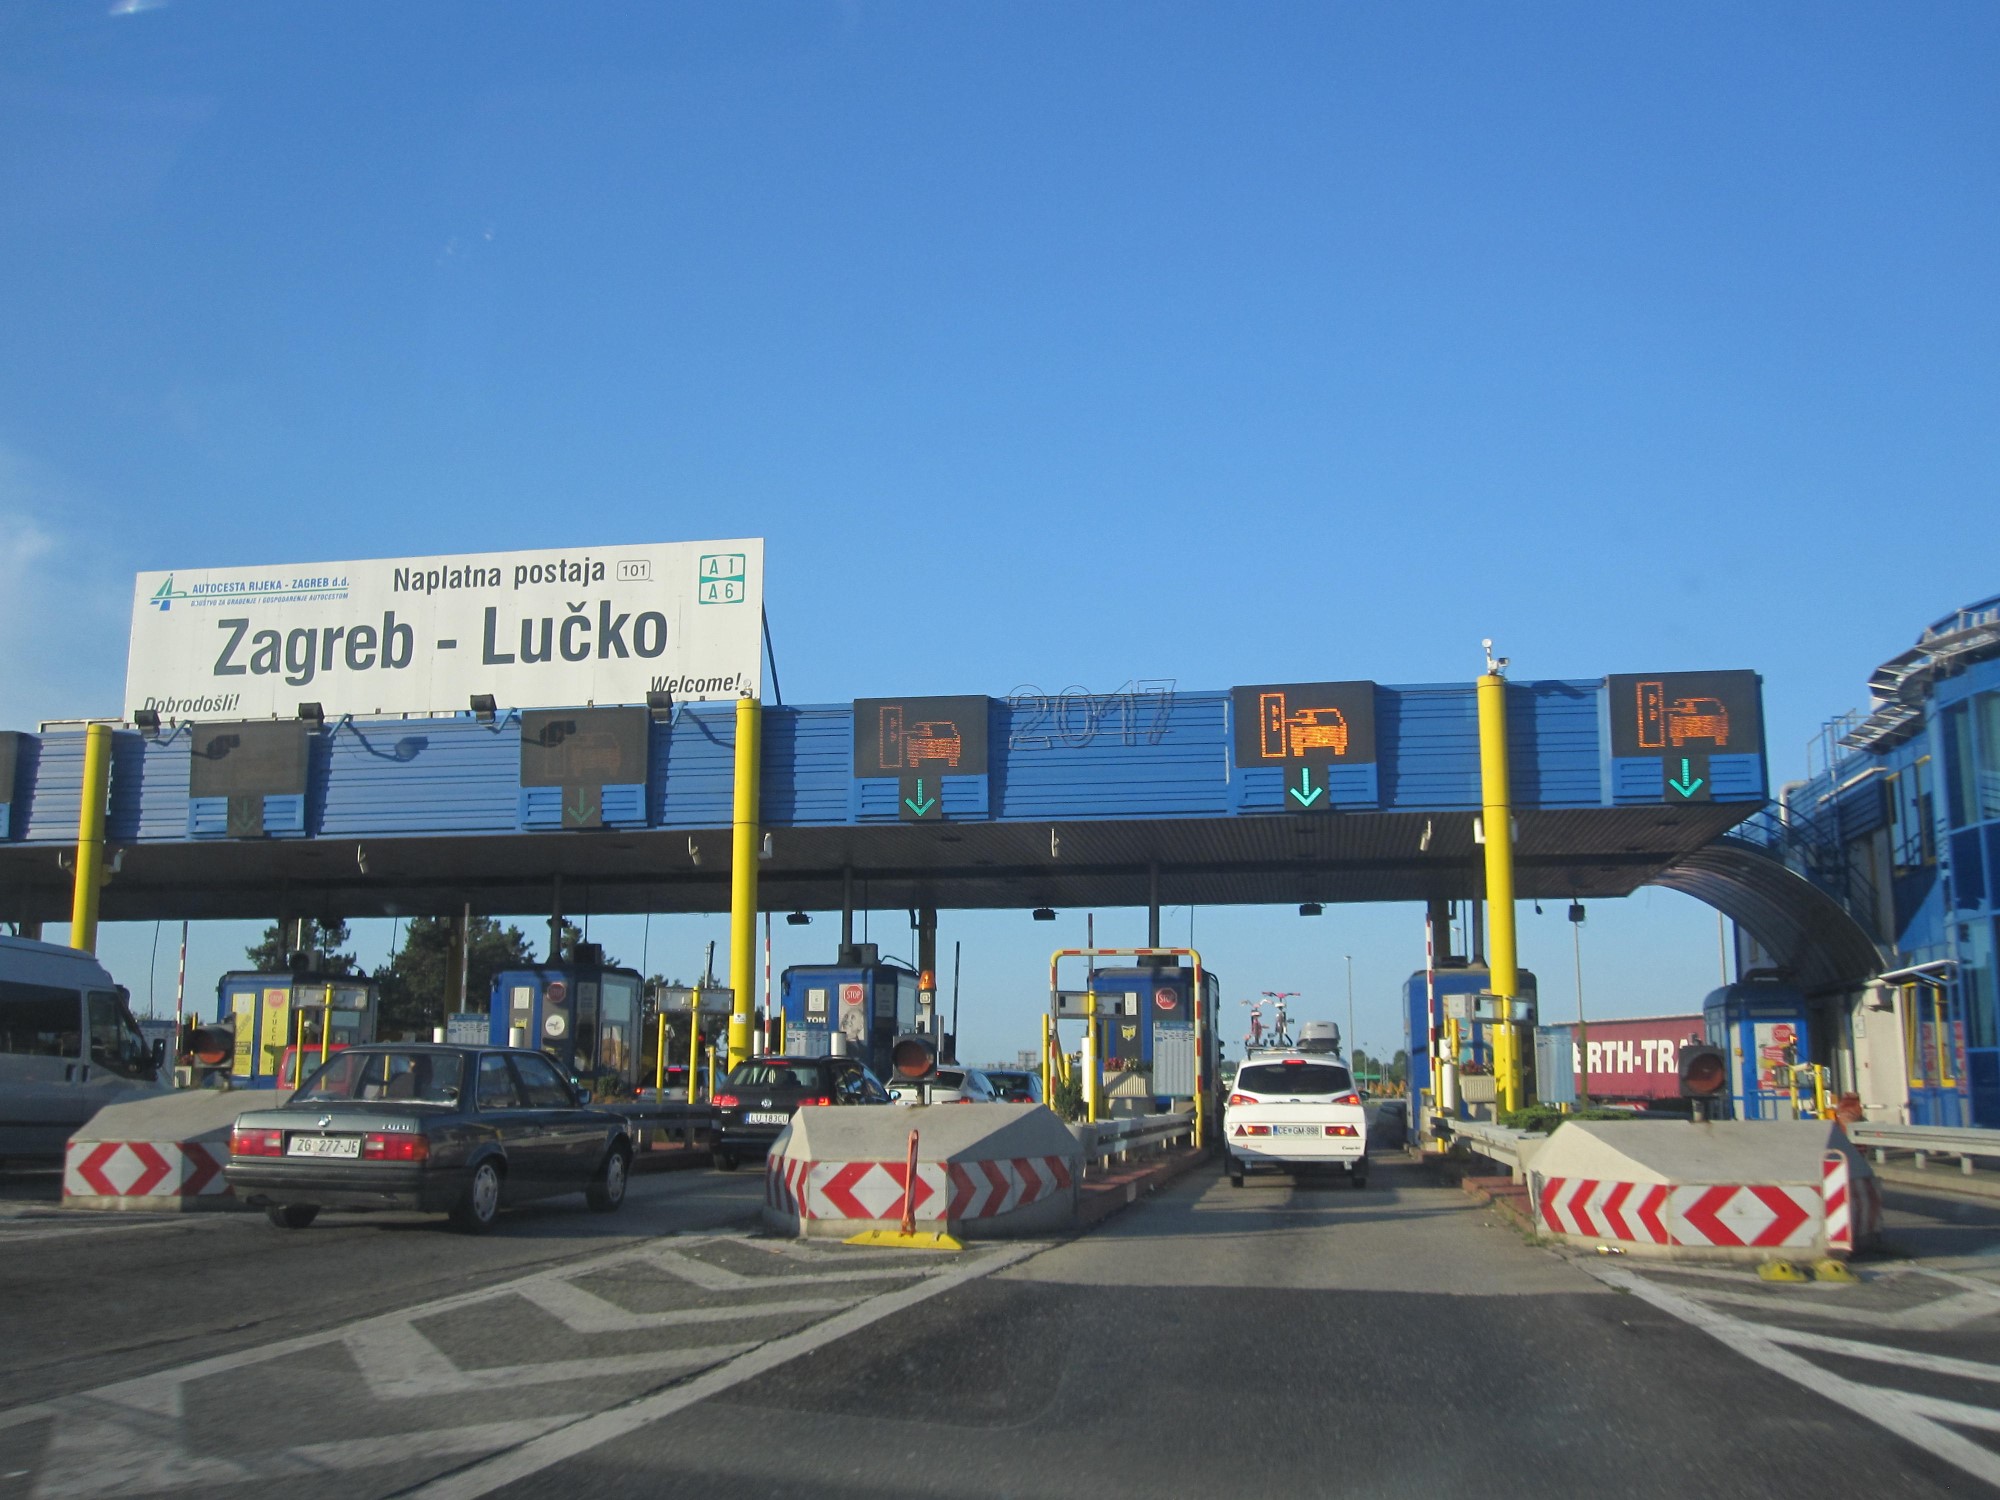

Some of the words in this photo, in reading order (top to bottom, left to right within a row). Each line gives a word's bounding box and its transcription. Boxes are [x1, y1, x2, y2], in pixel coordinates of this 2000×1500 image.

[192, 582, 246, 594] AUTOCESTA
[249, 580, 282, 591] RIJEKA
[292, 577, 329, 589] ZAGREB
[332, 576, 350, 587] d.d.
[394, 565, 501, 595] Naplatna
[514, 557, 605, 590] postaja
[622, 564, 646, 577] 101
[214, 610, 414, 687] Zagreb
[437, 639, 457, 649] -
[482, 600, 668, 666] Lučko
[651, 672, 742, 693] Welcome!
[144, 693, 240, 713] Dobrodošli!
[1007, 678, 1177, 750] 2017
[846, 990, 861, 999] STOP
[1278, 1126, 1288, 1135] CE
[297, 1138, 312, 1151] ZG
[318, 1139, 358, 1153] 277-JE
